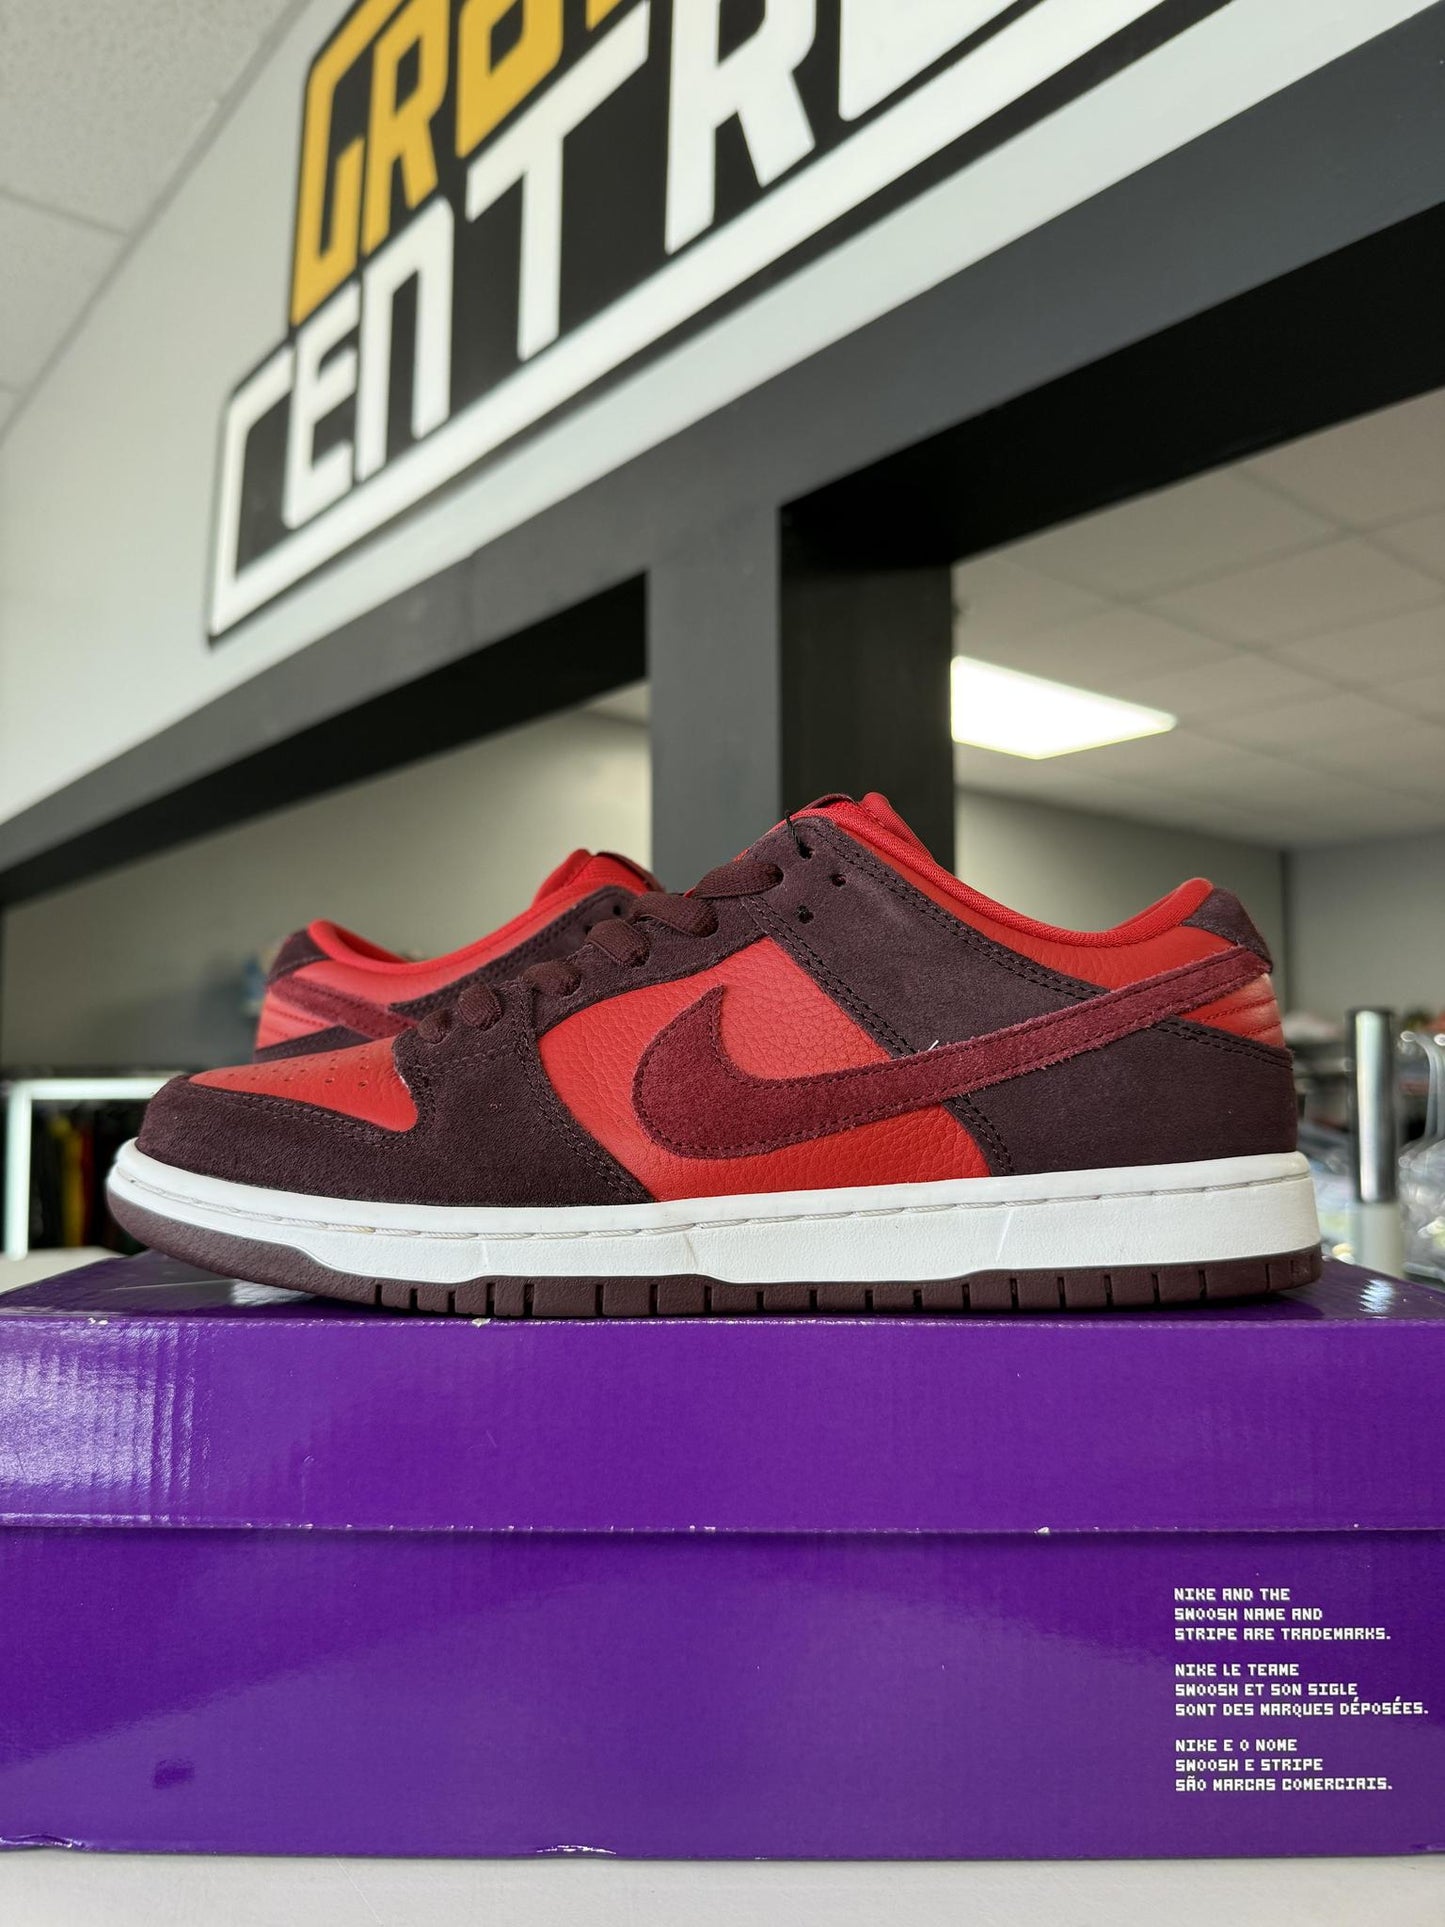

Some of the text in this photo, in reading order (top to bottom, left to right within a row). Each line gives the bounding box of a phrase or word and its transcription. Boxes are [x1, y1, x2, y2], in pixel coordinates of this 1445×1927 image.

[1174, 1587, 1291, 1601] NIKE AND THE
[1174, 1607, 1323, 1621] SWOOSH NAME AND
[1174, 1627, 1391, 1641] STRIPE ARE TRADEMARKS.
[1175, 1663, 1217, 1677] NIKE
[1222, 1663, 1242, 1677] LE
[1175, 1682, 1358, 1697] SWOOSH ET SON SIGLE
[1175, 1695, 1429, 1718] SONT DES MARQUES DÉPOSÉES.
[1175, 1738, 1298, 1753] NIKE E O NOME
[1175, 1758, 1324, 1773] SWOOSH E STRIPE
[1175, 1775, 1393, 1792] SÃO MARCAS COMERCIAIS.
